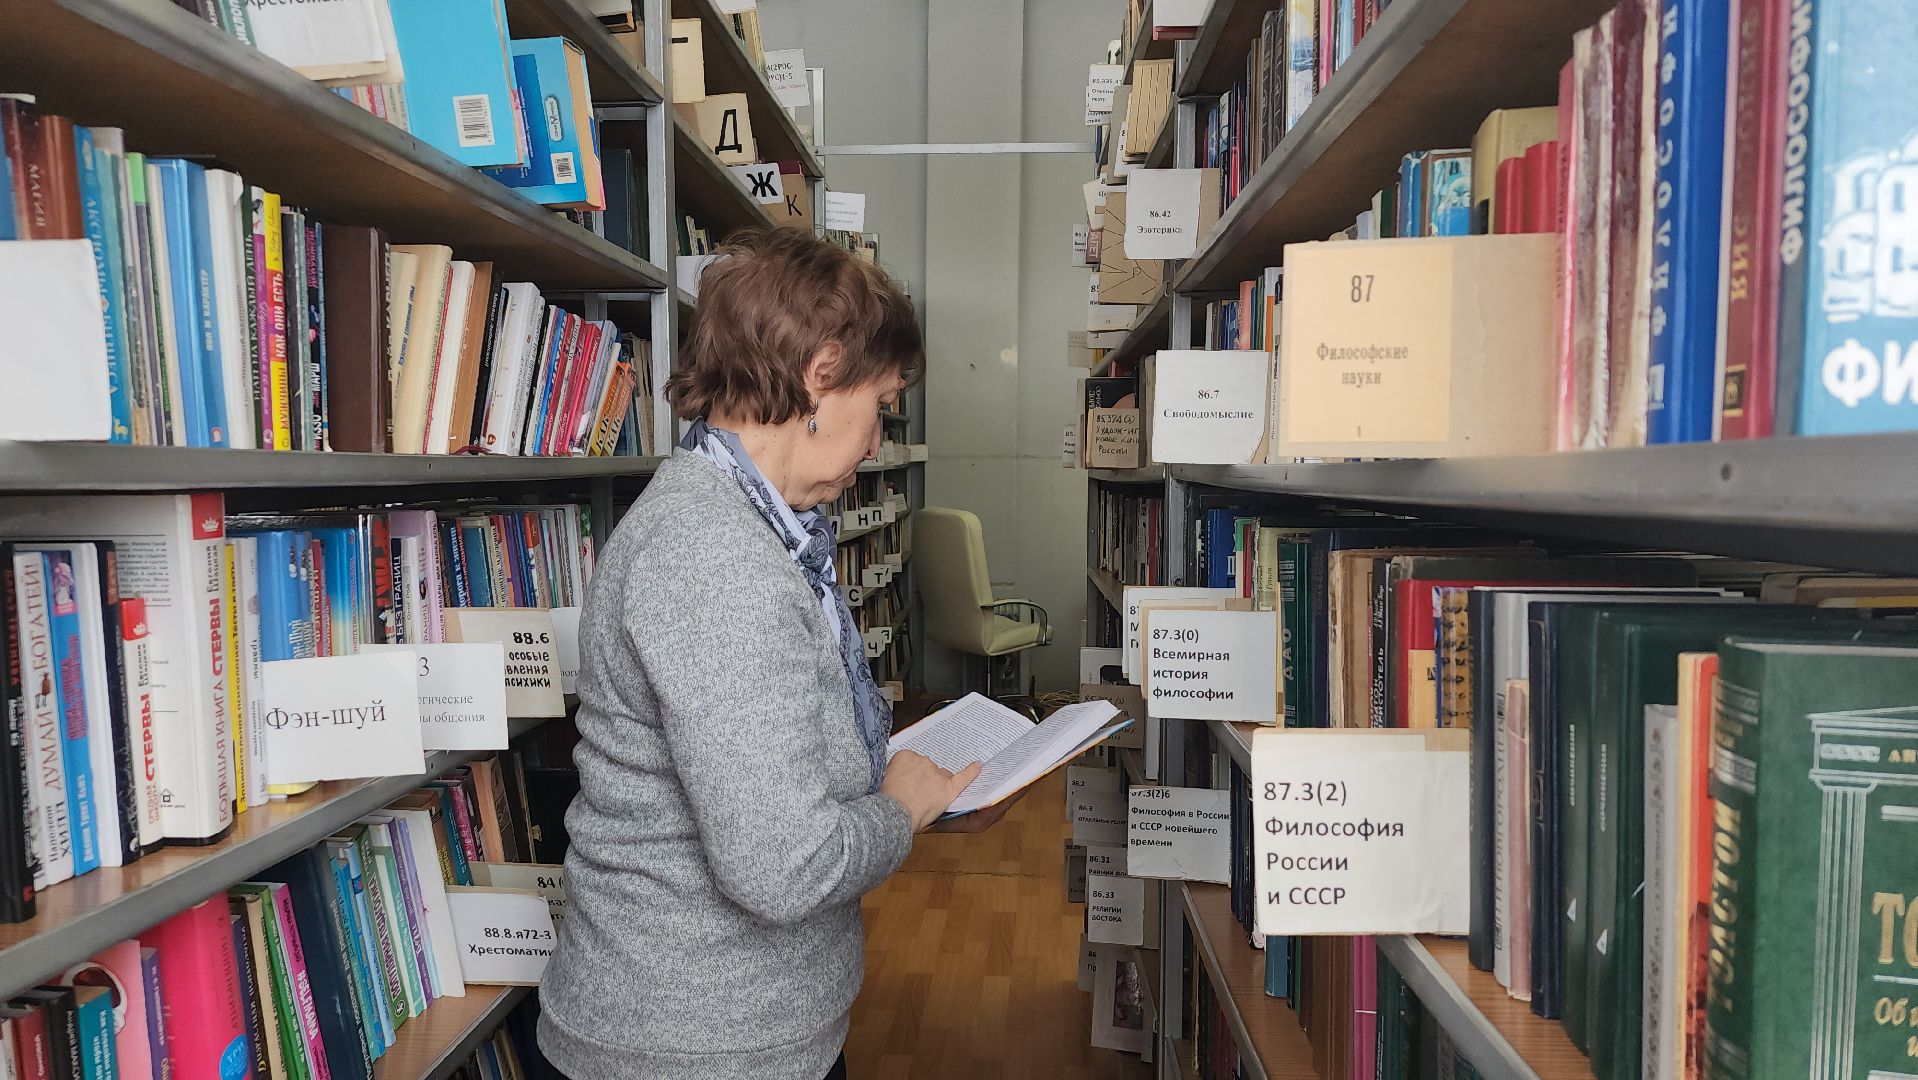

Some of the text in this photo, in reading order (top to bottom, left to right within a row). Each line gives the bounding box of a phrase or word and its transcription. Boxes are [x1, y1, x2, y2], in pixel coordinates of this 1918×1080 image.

[714, 108, 742, 155] Д
[1779, 0, 1814, 267] ФИЛОСОФИ
[746, 171, 778, 197] Ж
[785, 194, 802, 216] К
[1150, 210, 1171, 219] 86.42
[1136, 225, 1183, 235] Эзотерика
[1351, 275, 1375, 303] 87
[244, 275, 260, 340] КАЖДЫЙ
[271, 273, 288, 428] МУЖЧИНЫ КАК ОНИ ЕСТЬ
[1316, 342, 1409, 363] Философские
[1341, 370, 1382, 388] науки
[1197, 389, 1219, 399] 86.7
[1163, 409, 1254, 420] Свободомыслие
[858, 513, 868, 527] Н
[872, 509, 882, 522] П
[393, 555, 402, 606] ГРАНИЦ
[874, 572, 883, 584] Т
[849, 588, 860, 602] С
[25, 561, 52, 674] БОГАТЕЙ!
[512, 632, 550, 645] 88.6
[1152, 628, 1200, 643] 87.3(0)
[508, 650, 550, 663] особые
[1153, 648, 1230, 662] Всемирная
[1282, 627, 1293, 680] ДАО
[1153, 669, 1208, 680] история
[1153, 687, 1234, 700] философии
[208, 597, 230, 821] БОЛЬШАЯ КНИГА СТЕРВЫ
[265, 701, 386, 730] Фэн-шуй
[434, 711, 486, 725] общения
[140, 693, 156, 782] СТЕРВЫ
[34, 712, 63, 792] ДУМАЙ
[1263, 782, 1348, 807] 87.3(2)
[1131, 806, 1186, 819] Философия
[1196, 810, 1230, 820] России
[1139, 822, 1163, 831] СССР
[1164, 825, 1218, 835] новейшего
[1265, 817, 1405, 841] Философия
[1130, 838, 1173, 847] времени
[1266, 853, 1349, 872] России
[1092, 890, 1115, 899] 86.33
[1267, 887, 1346, 906] и СССР
[1092, 905, 1122, 914] РЕЛИГИИ
[296, 969, 319, 1041] #SELFMAMA
